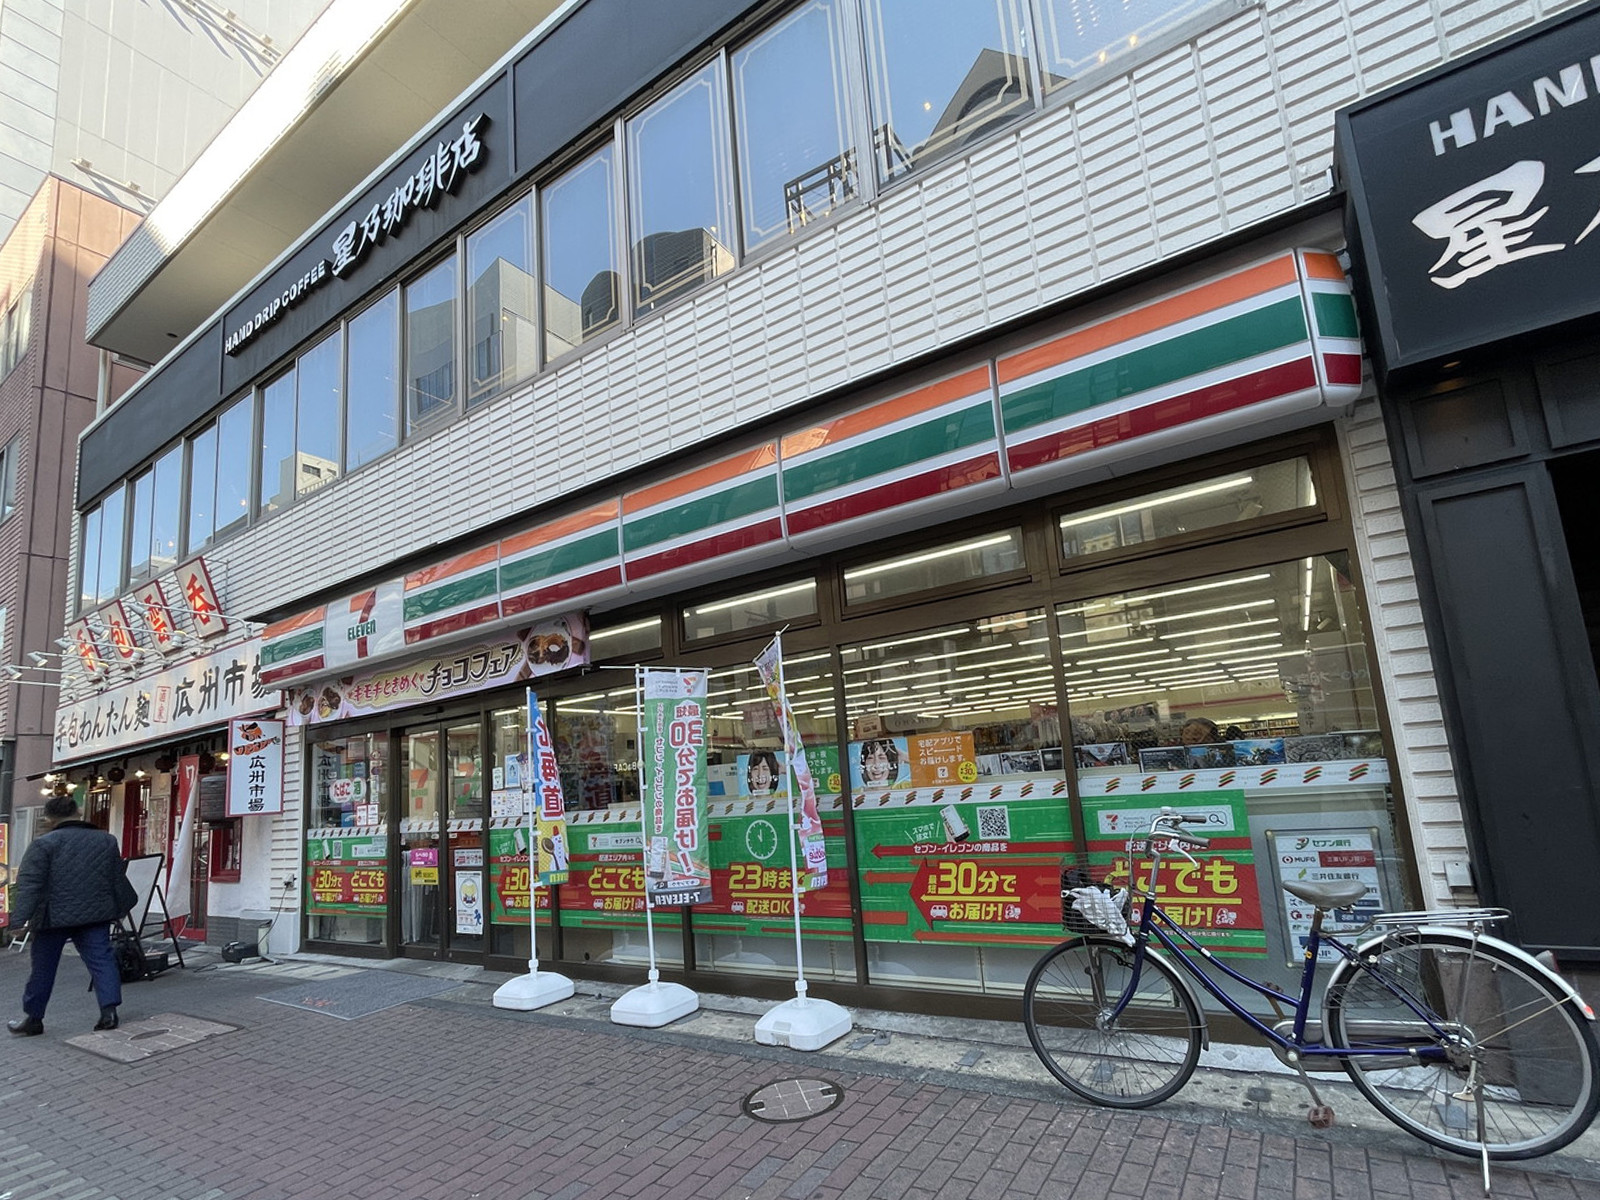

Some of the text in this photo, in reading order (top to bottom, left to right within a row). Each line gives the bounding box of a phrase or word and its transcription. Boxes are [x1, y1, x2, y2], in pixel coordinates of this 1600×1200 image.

[332, 112, 486, 277] 星乃珈琲店
[1411, 158, 1600, 289] 星
[225, 259, 326, 354] HAND DRIP COFFEE
[349, 589, 377, 659] 7
[353, 641, 523, 703] キモチときめく チョコフェア
[55, 690, 151, 753] 手包わんたん麺
[248, 755, 266, 812] 広州市場
[334, 782, 351, 797] たばこ
[1312, 839, 1352, 848] セブン銀行
[350, 870, 385, 888] どこでも
[588, 867, 645, 890] どこでも
[937, 862, 1017, 895] 30分で
[1311, 872, 1360, 881] 三井住友銀行
[746, 899, 791, 914] 配送OK
[949, 902, 1003, 921] お届け!
